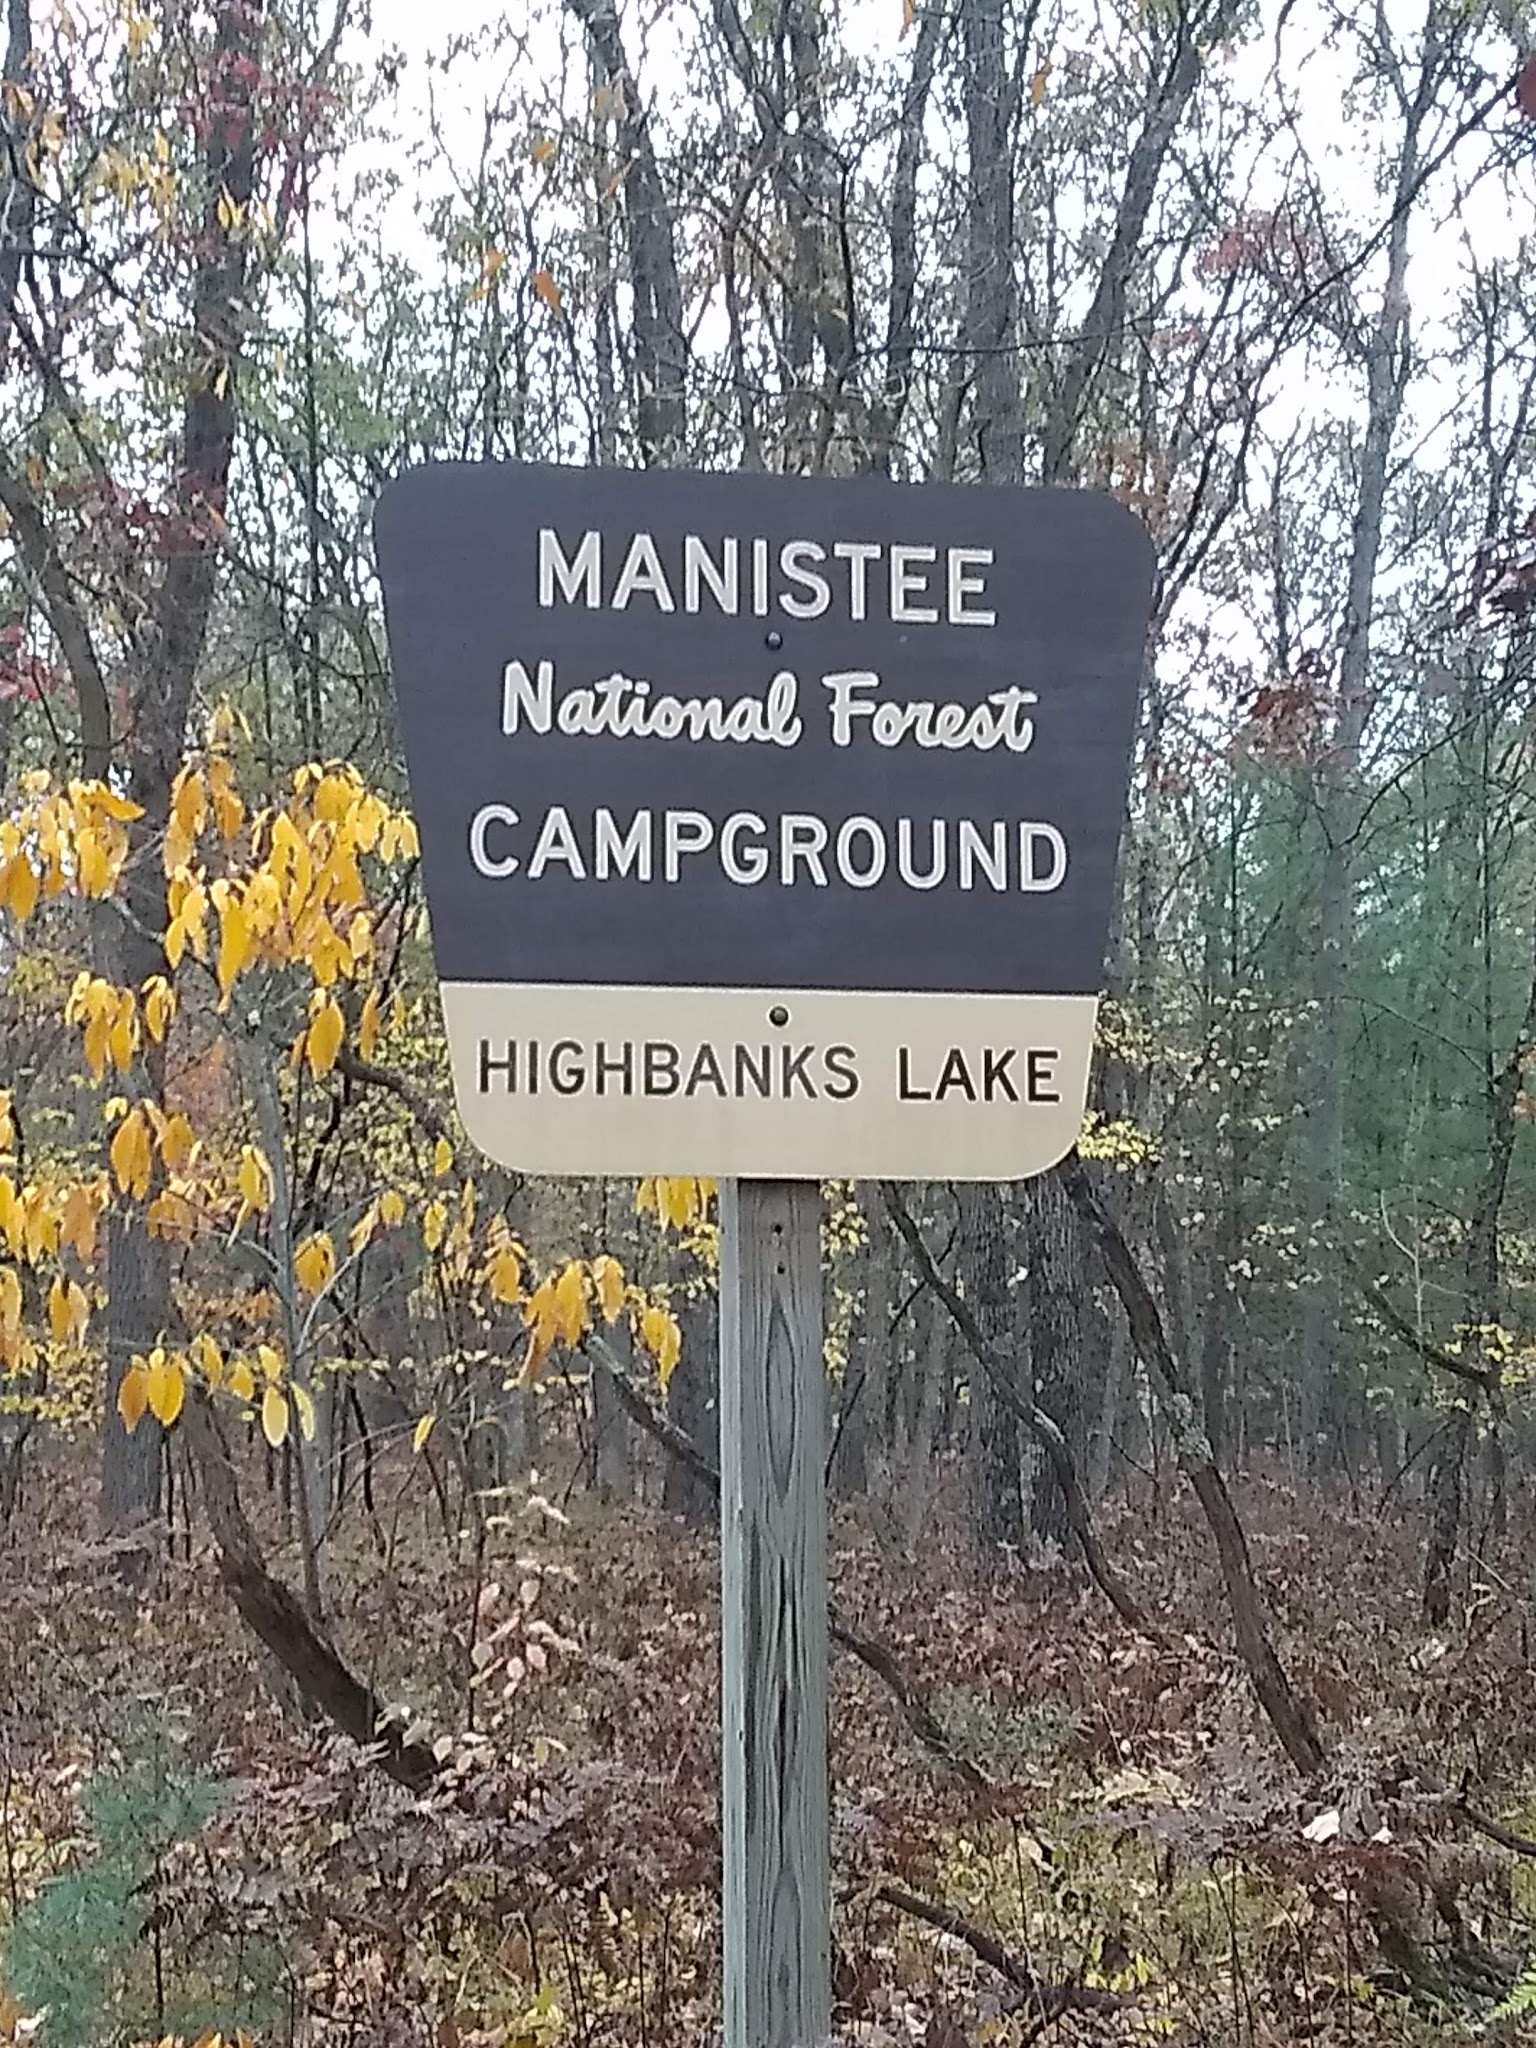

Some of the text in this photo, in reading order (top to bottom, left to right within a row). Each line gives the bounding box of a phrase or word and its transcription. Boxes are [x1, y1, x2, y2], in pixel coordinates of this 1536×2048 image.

[538, 528, 997, 627] MANISTEE
[502, 660, 1038, 753] National Forest
[469, 803, 1068, 892] CAMPGROUND
[479, 1038, 1060, 1103] HIGHBANKS LAKE
